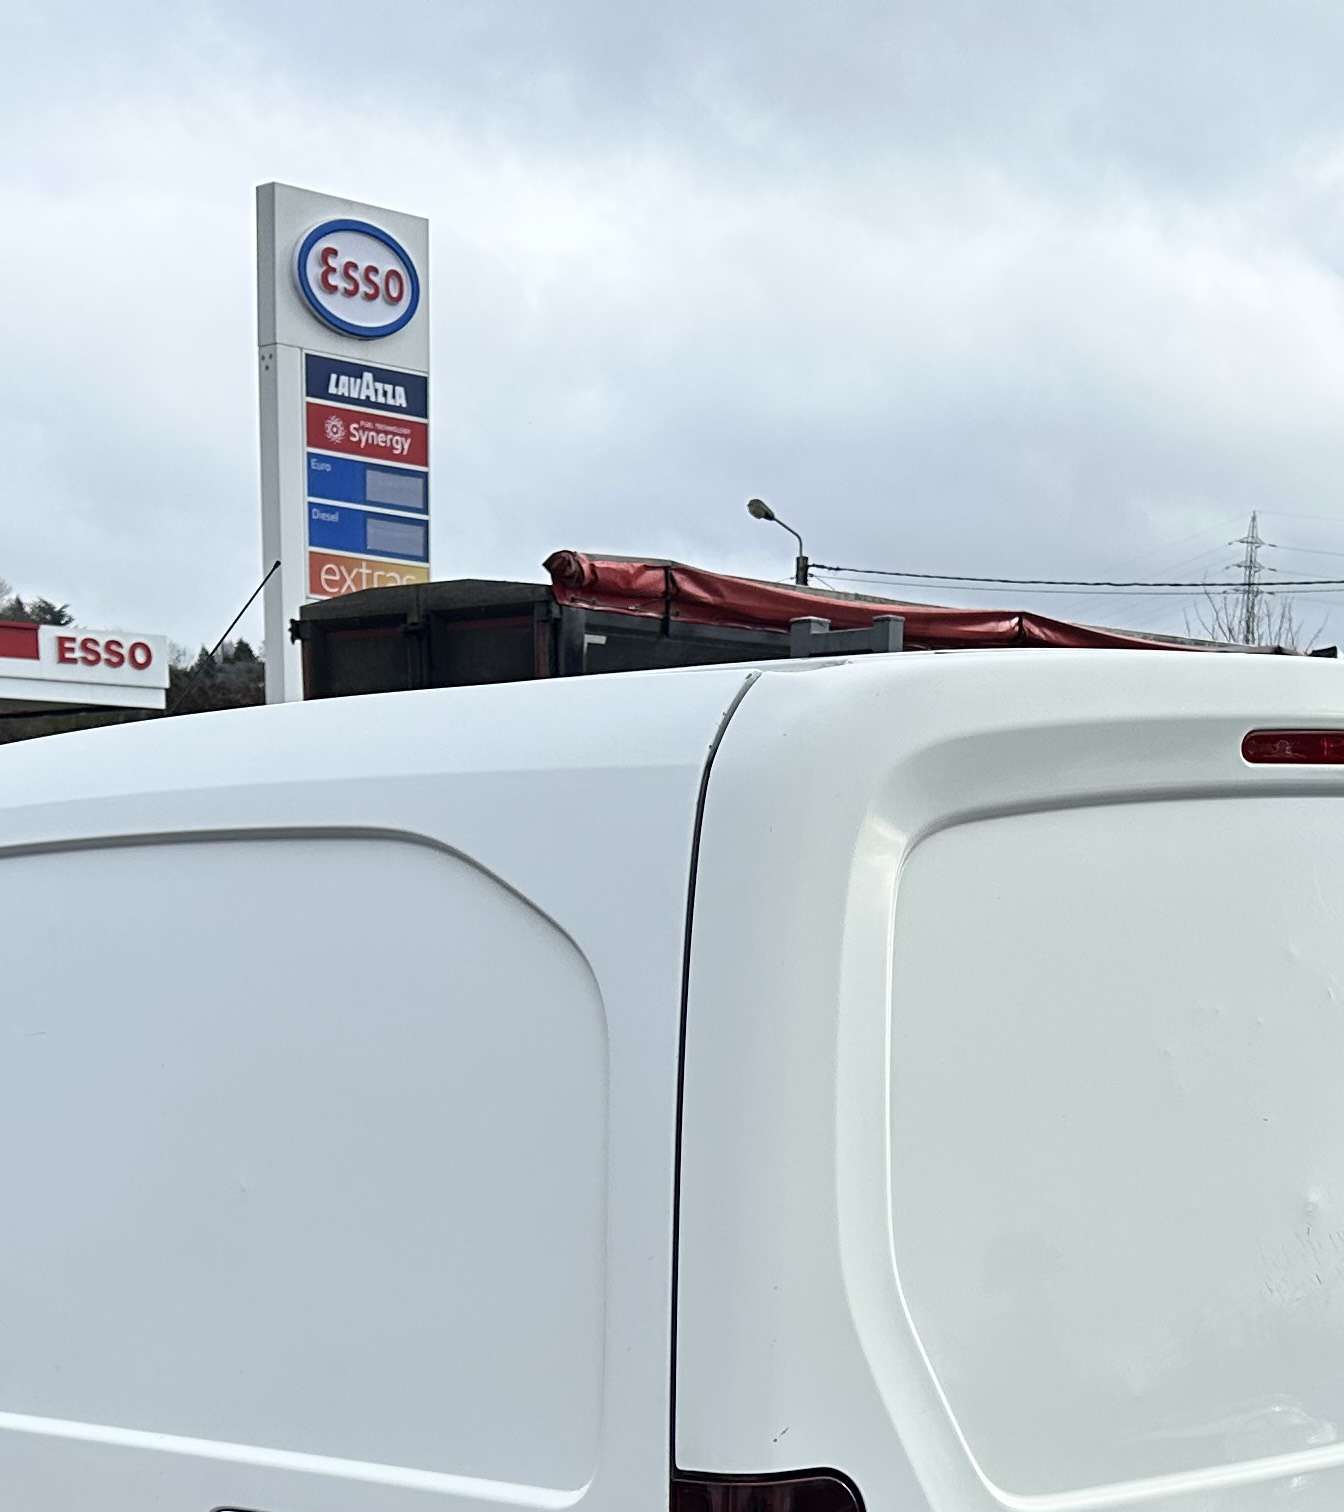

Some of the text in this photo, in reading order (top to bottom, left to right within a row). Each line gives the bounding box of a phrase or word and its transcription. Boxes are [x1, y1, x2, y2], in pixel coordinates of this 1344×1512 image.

[349, 423, 412, 455] Synergy
[310, 458, 332, 472] Euro
[311, 508, 339, 522] Diesel
[57, 636, 153, 670] ESSO
